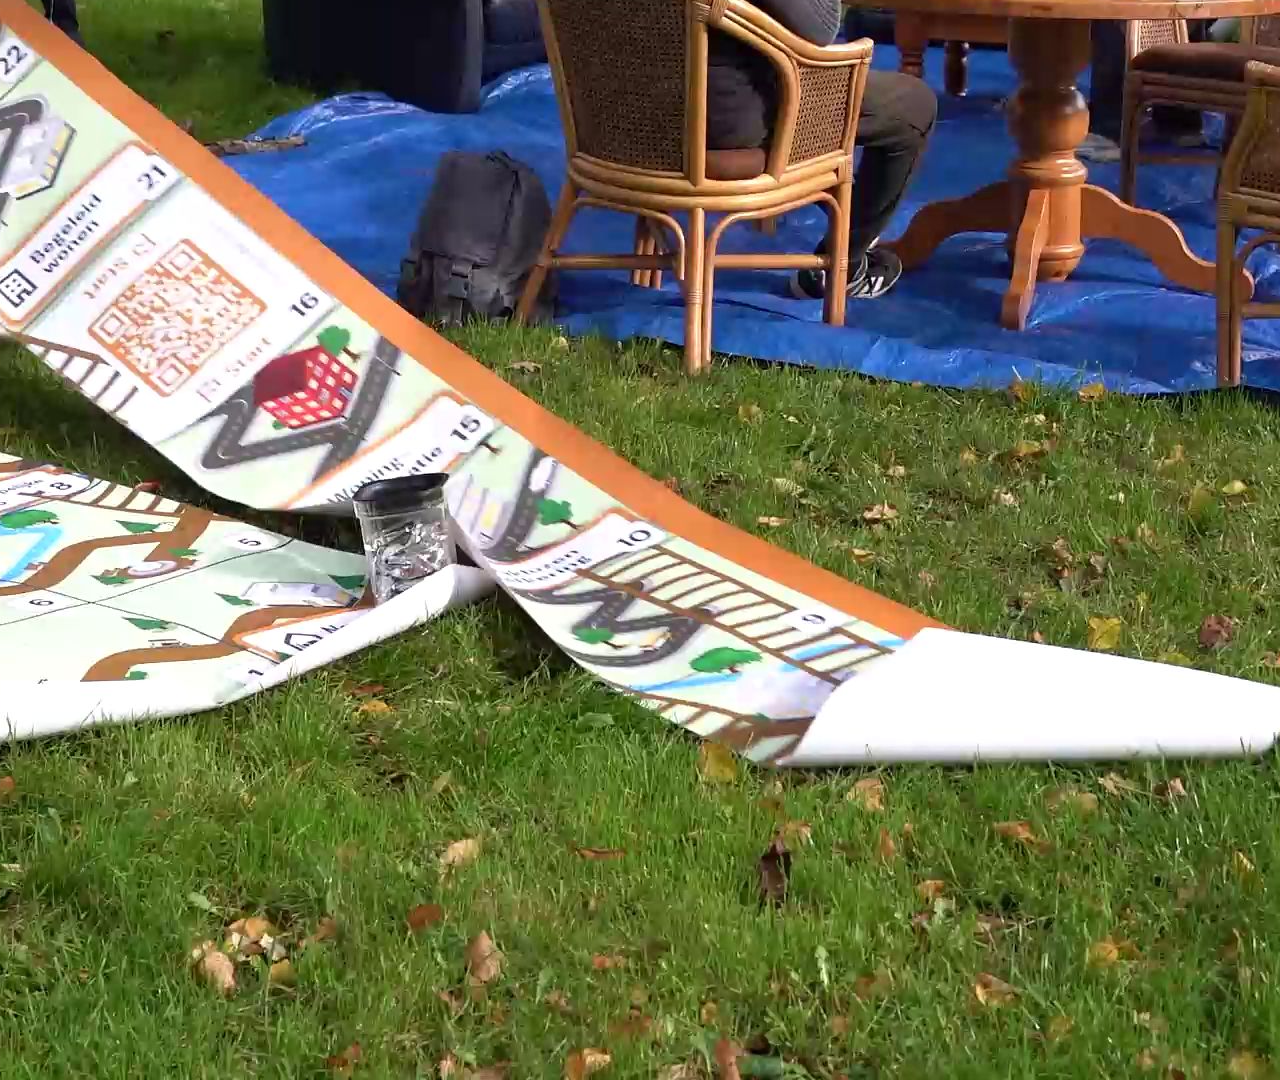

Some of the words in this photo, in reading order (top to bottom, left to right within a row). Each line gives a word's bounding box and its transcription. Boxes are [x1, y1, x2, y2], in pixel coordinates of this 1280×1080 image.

[137, 164, 167, 190] 21
[29, 193, 103, 264] Begeleid
[43, 220, 100, 274] wonen
[289, 291, 320, 317] 16
[450, 415, 481, 441] 15
[50, 481, 72, 491] 8
[238, 537, 261, 548] 5
[616, 529, 652, 547] 10
[30, 598, 55, 608] 6
